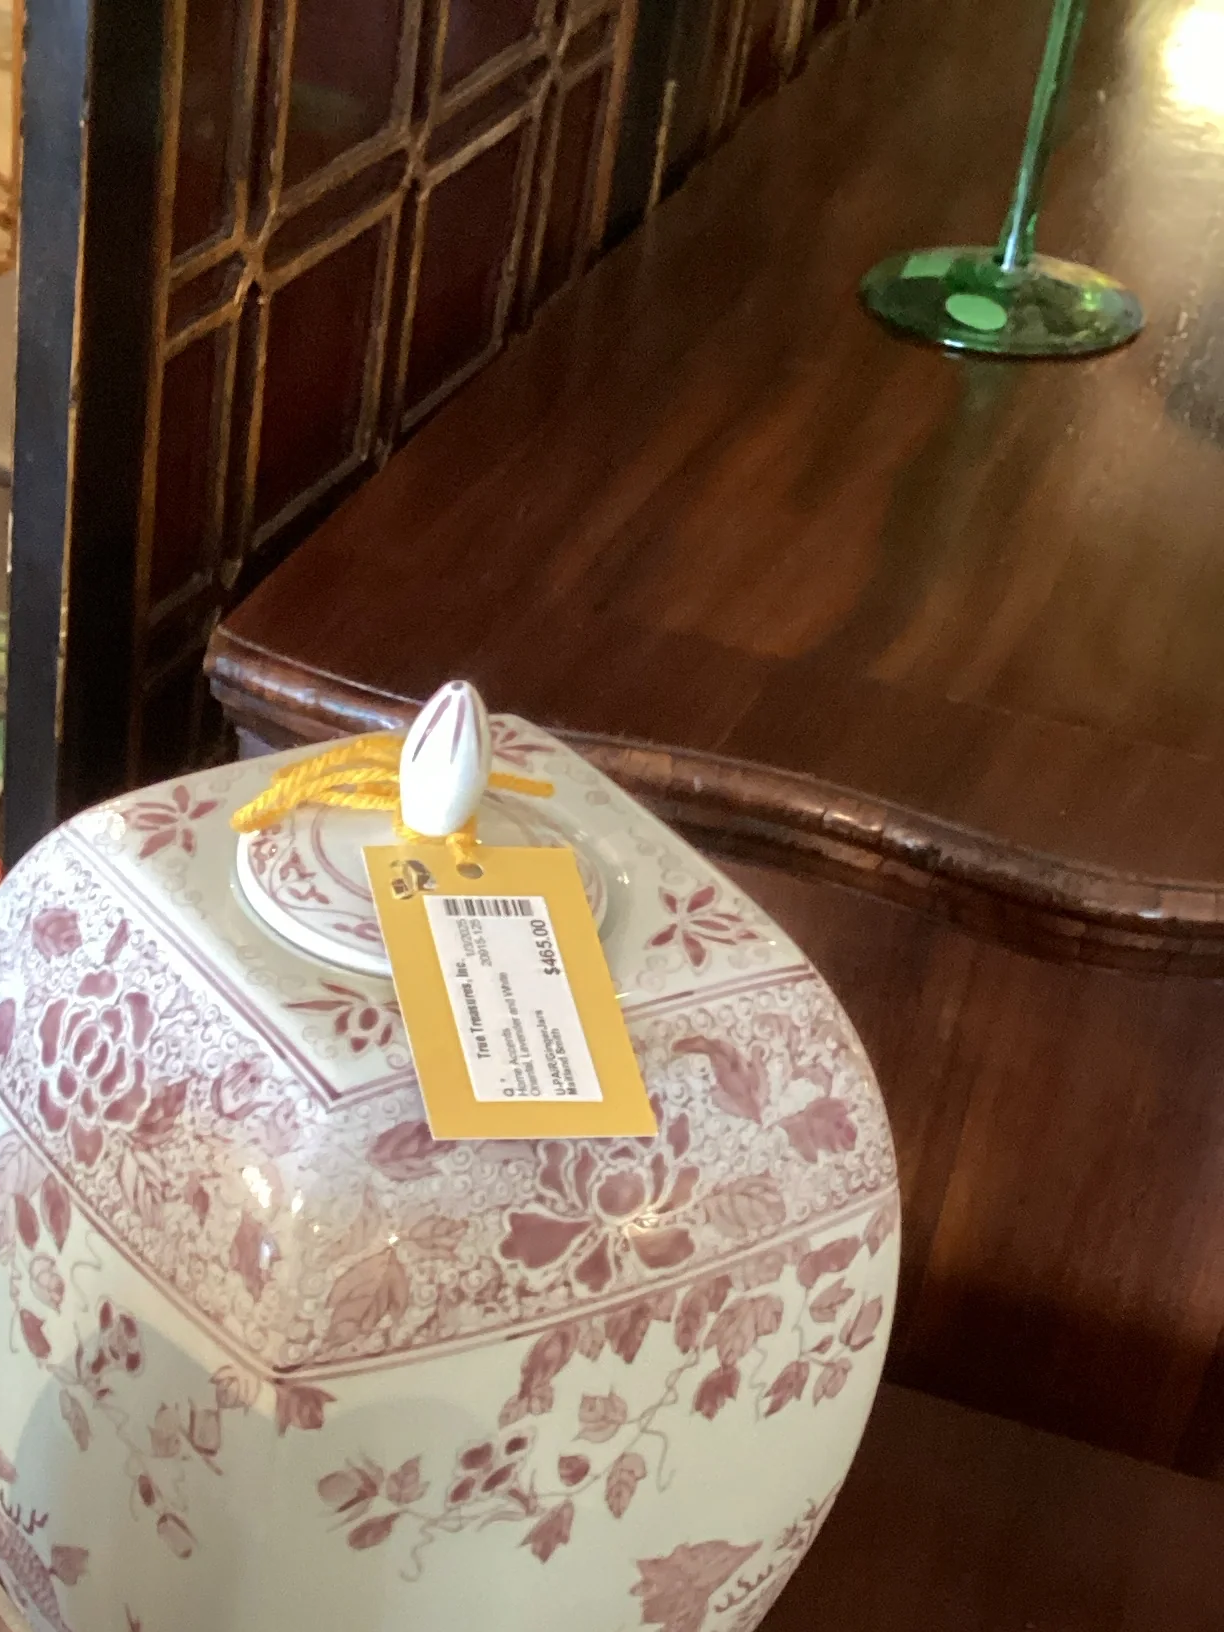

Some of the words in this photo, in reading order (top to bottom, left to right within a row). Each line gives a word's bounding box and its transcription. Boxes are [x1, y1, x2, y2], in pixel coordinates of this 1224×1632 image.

[530, 920, 560, 975] $465.00
[499, 972, 513, 997] White
[505, 998, 518, 1014] and
[475, 1036, 491, 1058] True
[502, 1027, 518, 1064] Accents
[512, 1017, 530, 1056] Lavender
[550, 1028, 565, 1054] Smith
[513, 1068, 528, 1095] Home
[558, 1056, 575, 1094] Maitland
